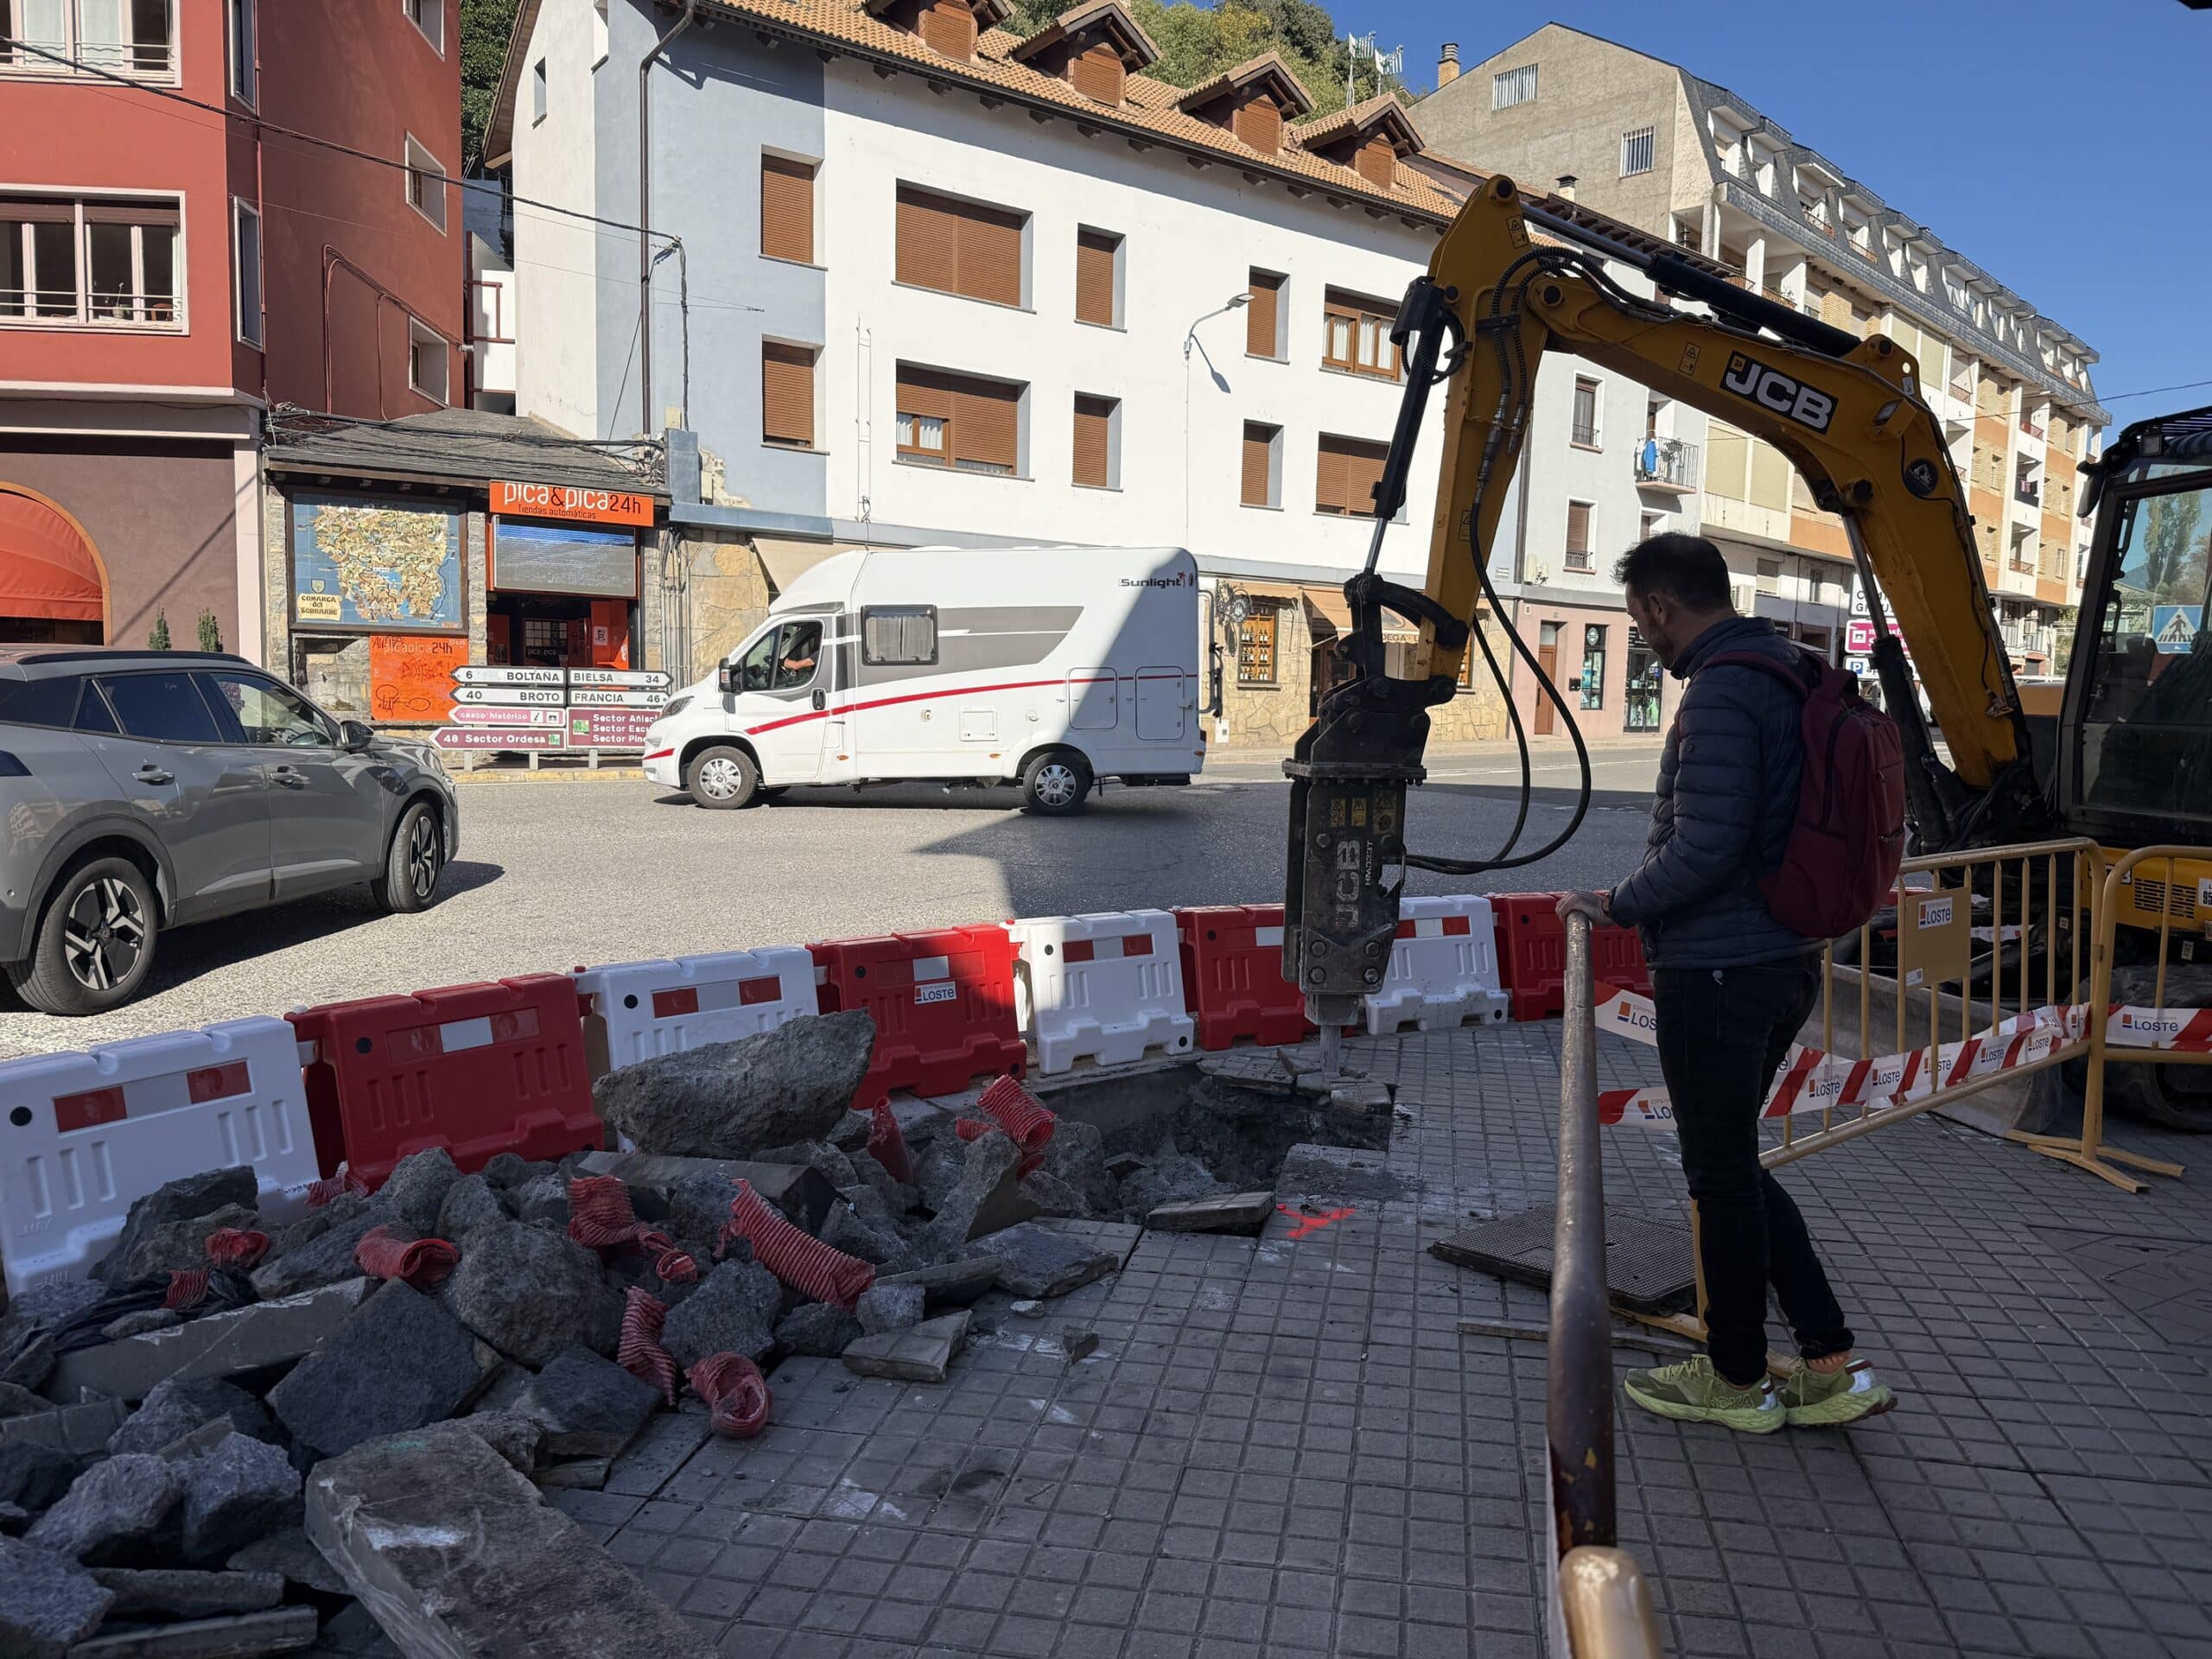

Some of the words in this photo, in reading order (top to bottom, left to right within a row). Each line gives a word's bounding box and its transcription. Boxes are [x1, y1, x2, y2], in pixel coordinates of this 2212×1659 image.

[1726, 363, 1832, 429] JCB
[518, 504, 547, 516] Tiendas
[549, 508, 596, 520] automáticas
[1121, 578, 1181, 588] Sunlight
[466, 671, 473, 679] 6
[506, 671, 560, 682] BOLTAÑA
[574, 672, 613, 683] BIELSA
[645, 675, 659, 683] 34
[466, 690, 482, 700] 40
[520, 691, 560, 702] BROTO
[575, 693, 624, 702] FRANCIA
[646, 694, 660, 702] 46
[593, 714, 626, 722] Sector
[593, 724, 626, 733] Sector
[465, 734, 503, 743] Sector
[506, 734, 546, 743] Ordesa
[1335, 840, 1360, 928] JCB
[1630, 1012, 1658, 1031] LOS
